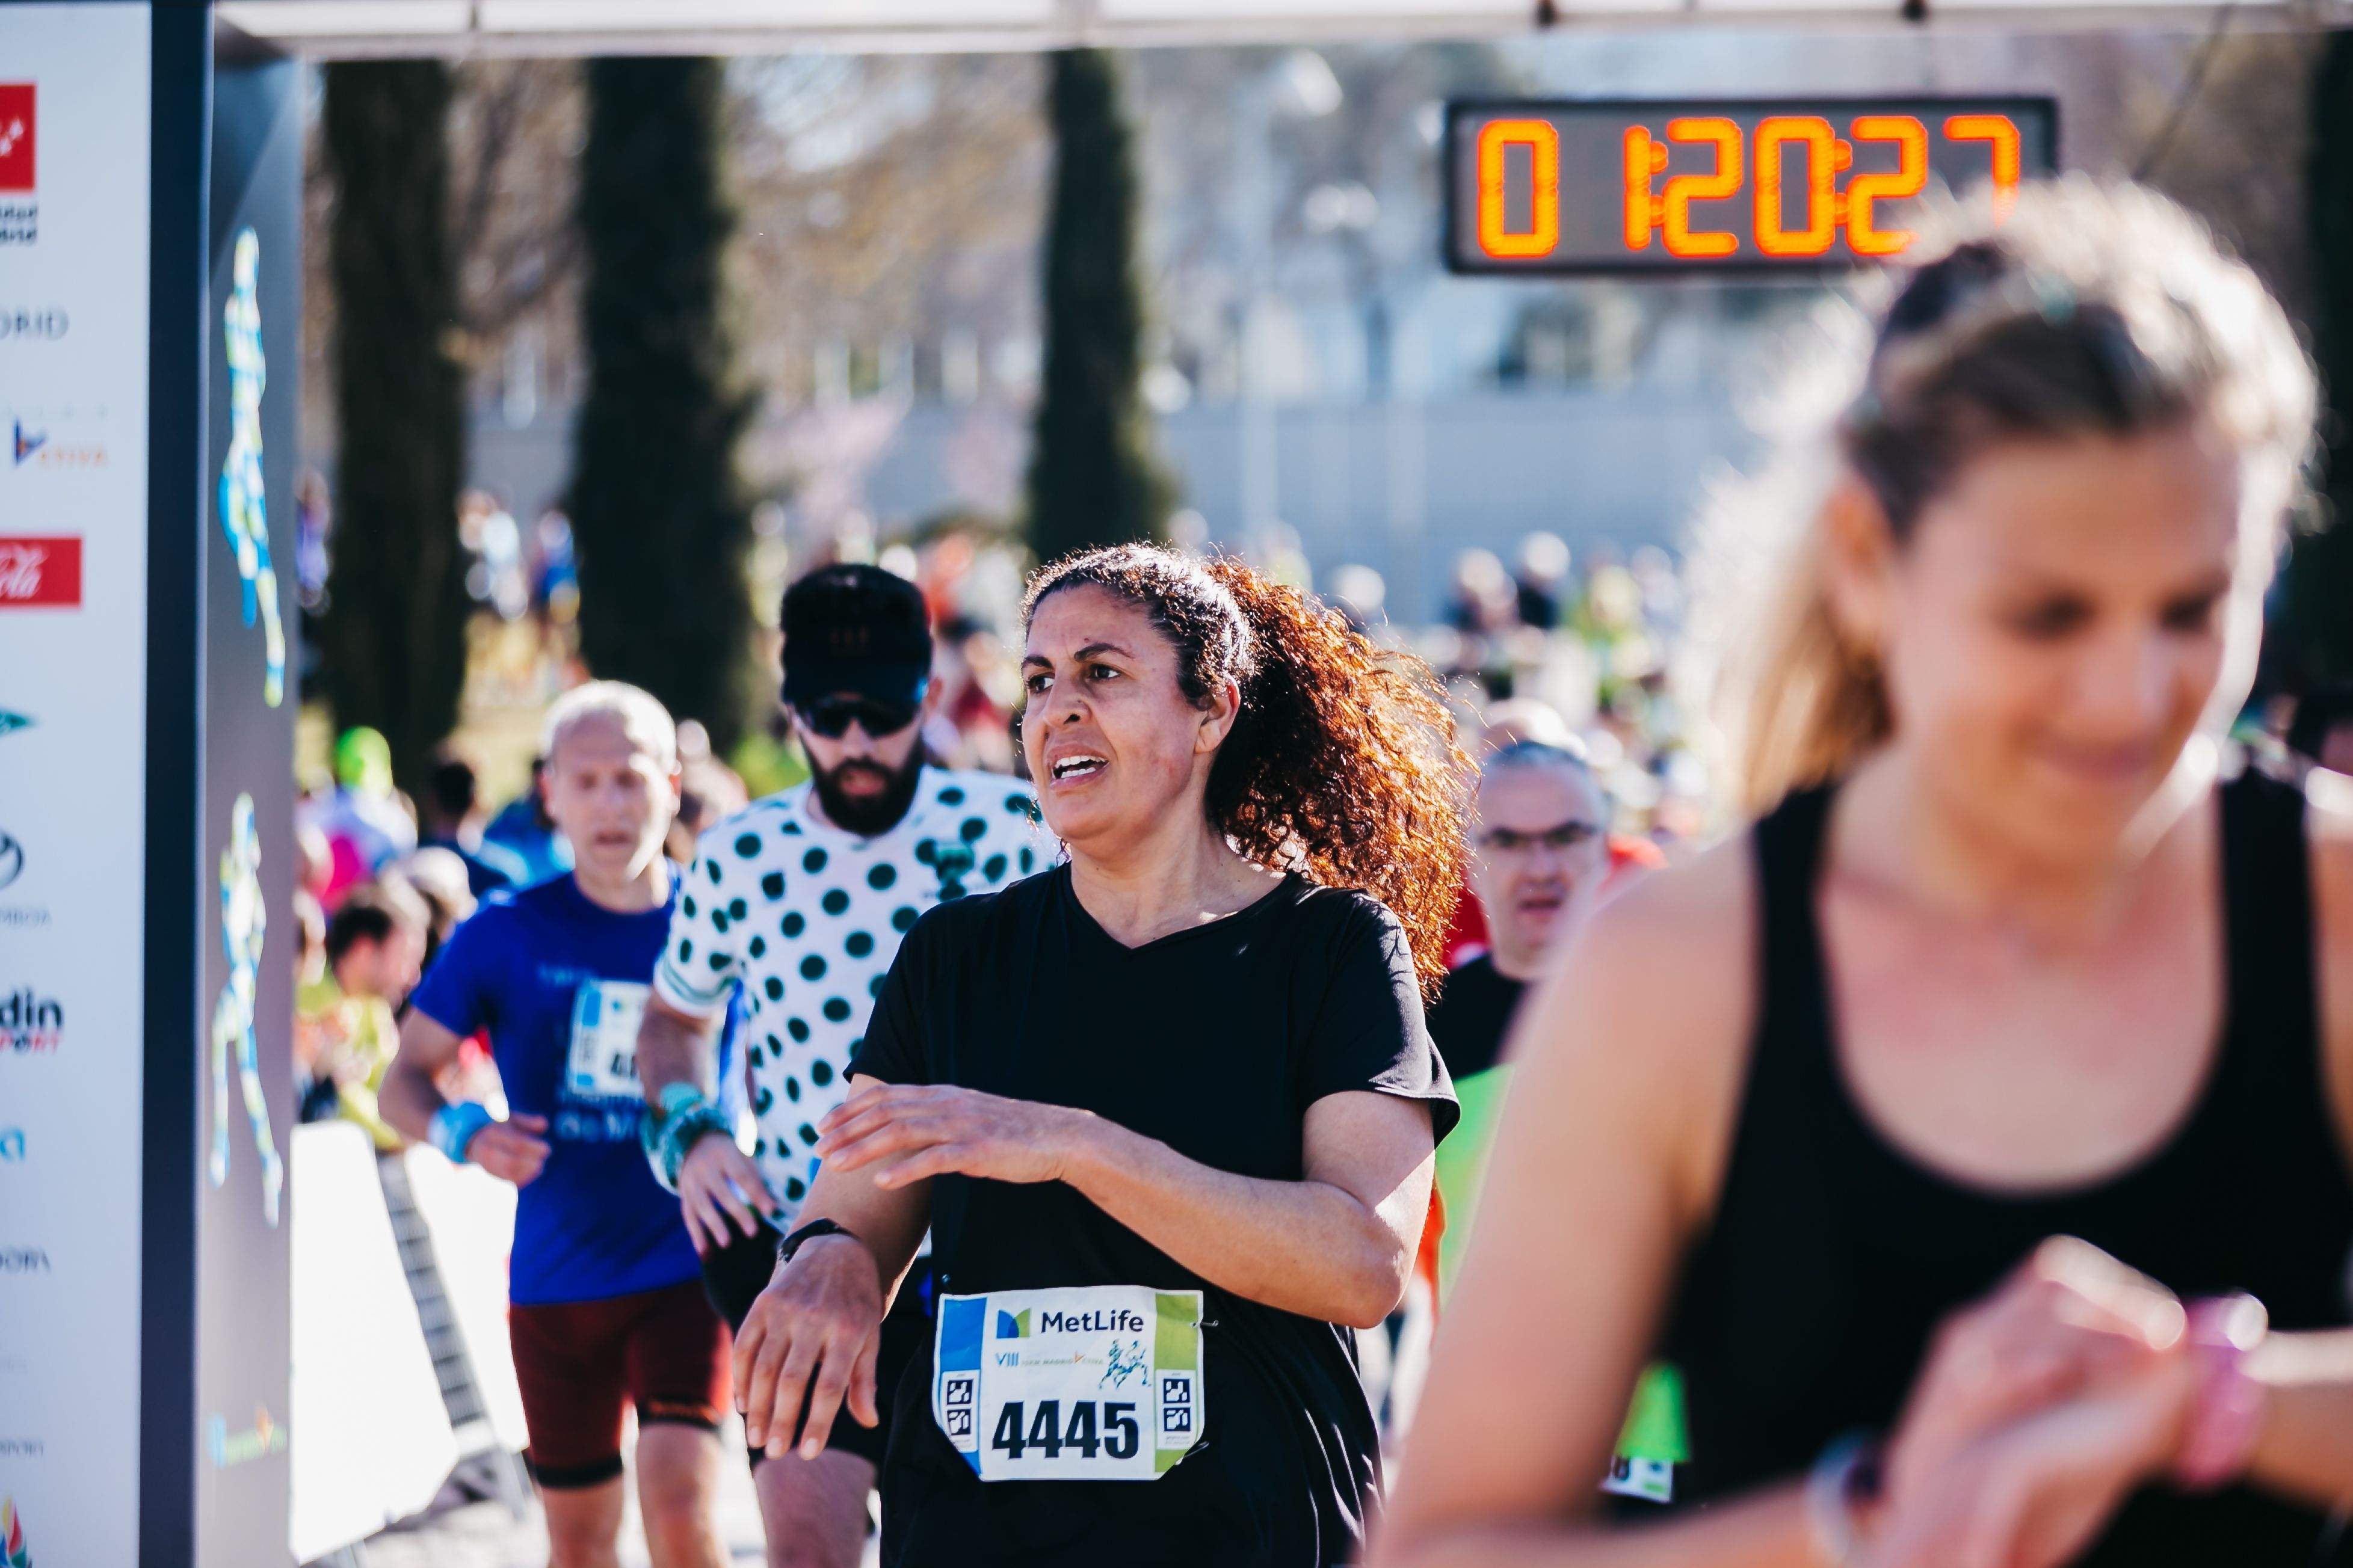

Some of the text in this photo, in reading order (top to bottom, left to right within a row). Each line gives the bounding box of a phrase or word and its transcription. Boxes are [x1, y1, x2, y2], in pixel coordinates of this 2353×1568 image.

[1041, 1309, 1144, 1333] MetLife
[995, 1352, 1019, 1367] VIII
[992, 1398, 1139, 1460] 4445
